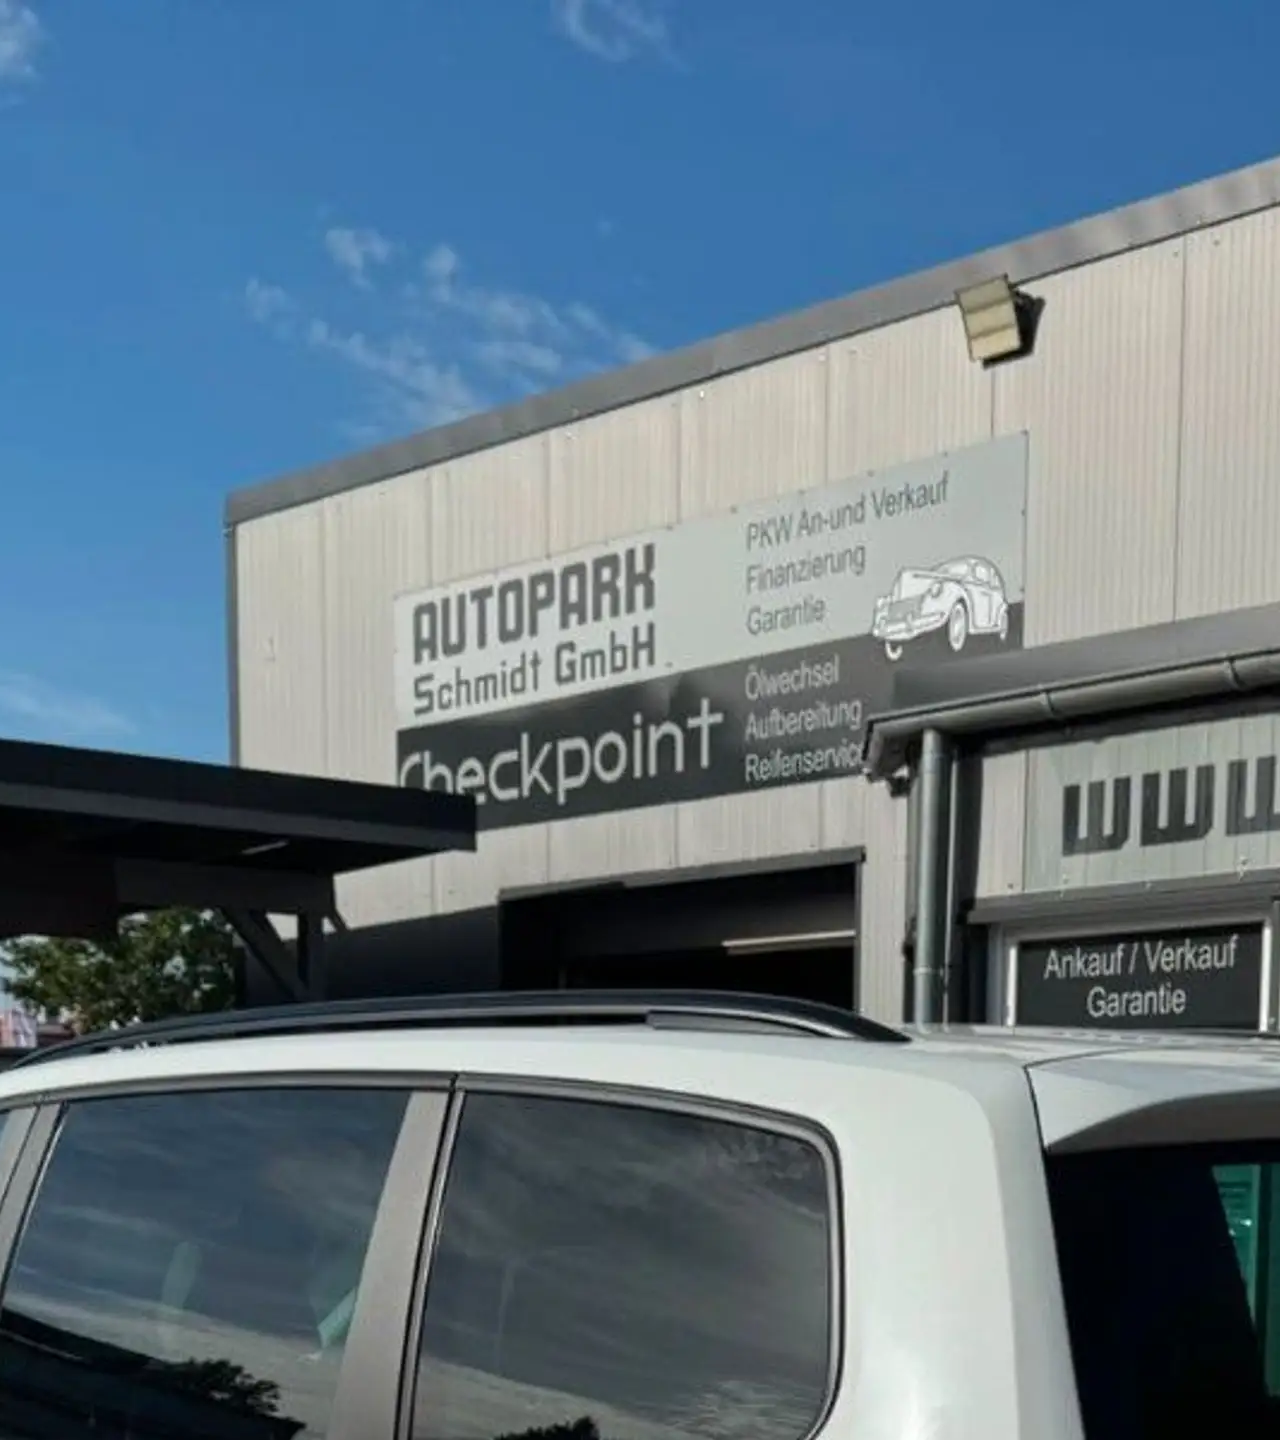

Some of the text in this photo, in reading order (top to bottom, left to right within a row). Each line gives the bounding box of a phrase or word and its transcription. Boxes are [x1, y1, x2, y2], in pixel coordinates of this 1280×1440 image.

[746, 469, 950, 551] PKW An-und Verkauf
[746, 543, 867, 594] Finanzierung
[413, 542, 656, 665] AUTOPARK
[746, 594, 826, 636] Garantie
[413, 621, 656, 718] Schmidt GmbH
[745, 653, 841, 701] Ölwechsel
[745, 699, 862, 744] Aufbereitung
[399, 696, 724, 806] Checkpoint
[1043, 942, 1125, 980] Ankauf
[1143, 934, 1239, 973] Verkauf
[1086, 981, 1187, 1019] Garantie
